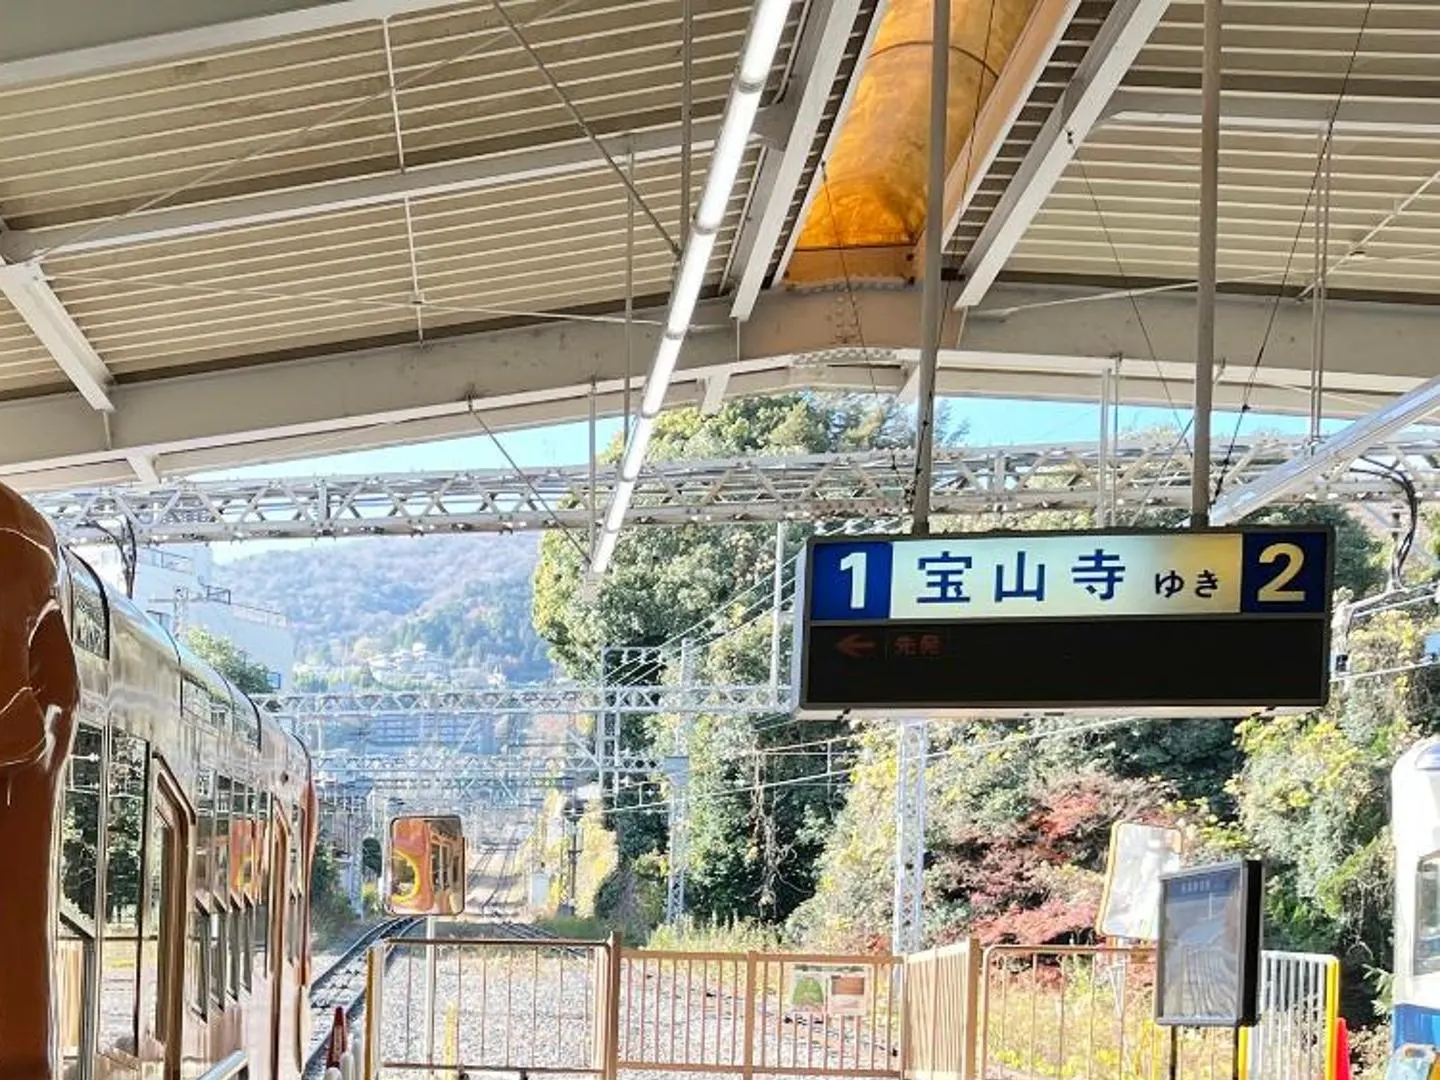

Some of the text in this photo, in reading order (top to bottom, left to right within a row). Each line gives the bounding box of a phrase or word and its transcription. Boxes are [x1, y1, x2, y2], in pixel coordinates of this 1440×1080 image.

[840, 551, 868, 609] 1
[916, 548, 1220, 605] 宝山寺 ゆき
[1257, 542, 1307, 603] 2
